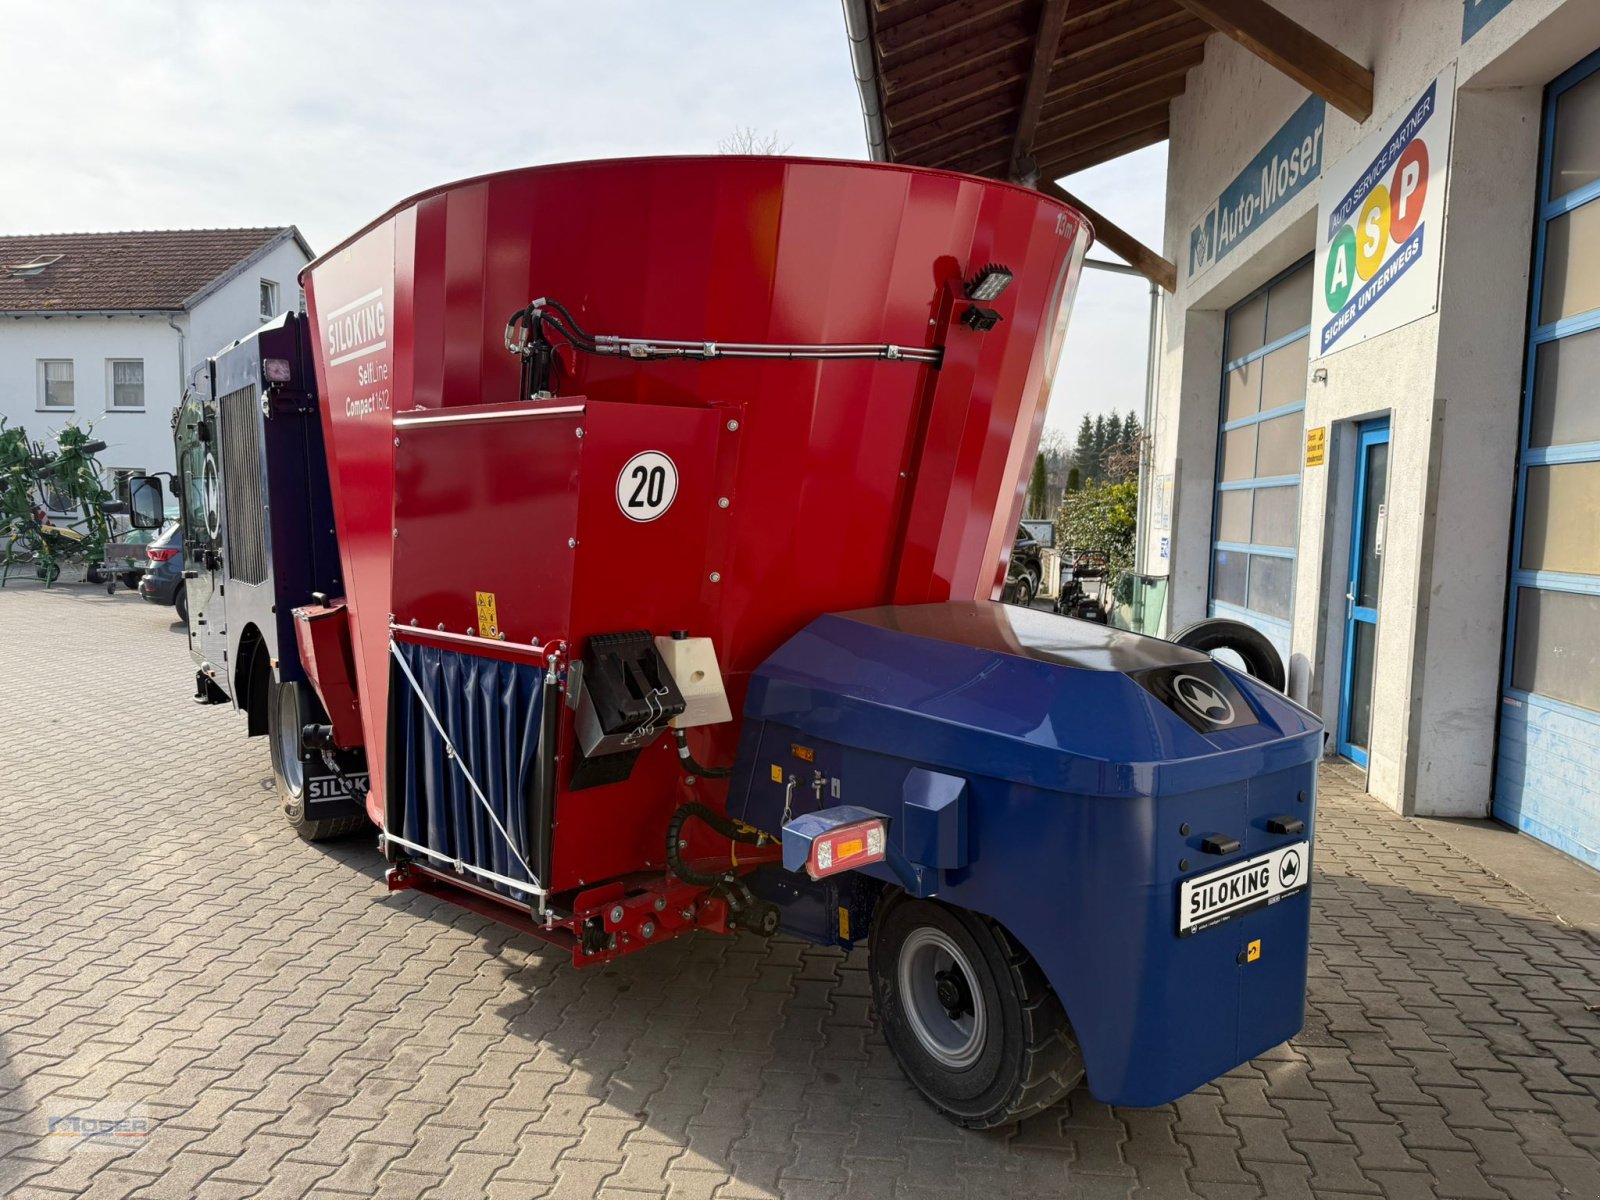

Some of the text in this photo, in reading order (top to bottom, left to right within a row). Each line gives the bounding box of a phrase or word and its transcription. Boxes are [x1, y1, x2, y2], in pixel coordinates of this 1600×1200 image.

[1218, 123, 1323, 251] Auto-Moser
[1332, 96, 1431, 231] AUTO SERVICE PARTNER
[1324, 237, 1419, 345] SICHER UNTERWEGS
[328, 301, 385, 356] SILOKING
[358, 361, 388, 386] SelfLine
[628, 465, 666, 508] 20
[1190, 867, 1270, 914] SILOKING
